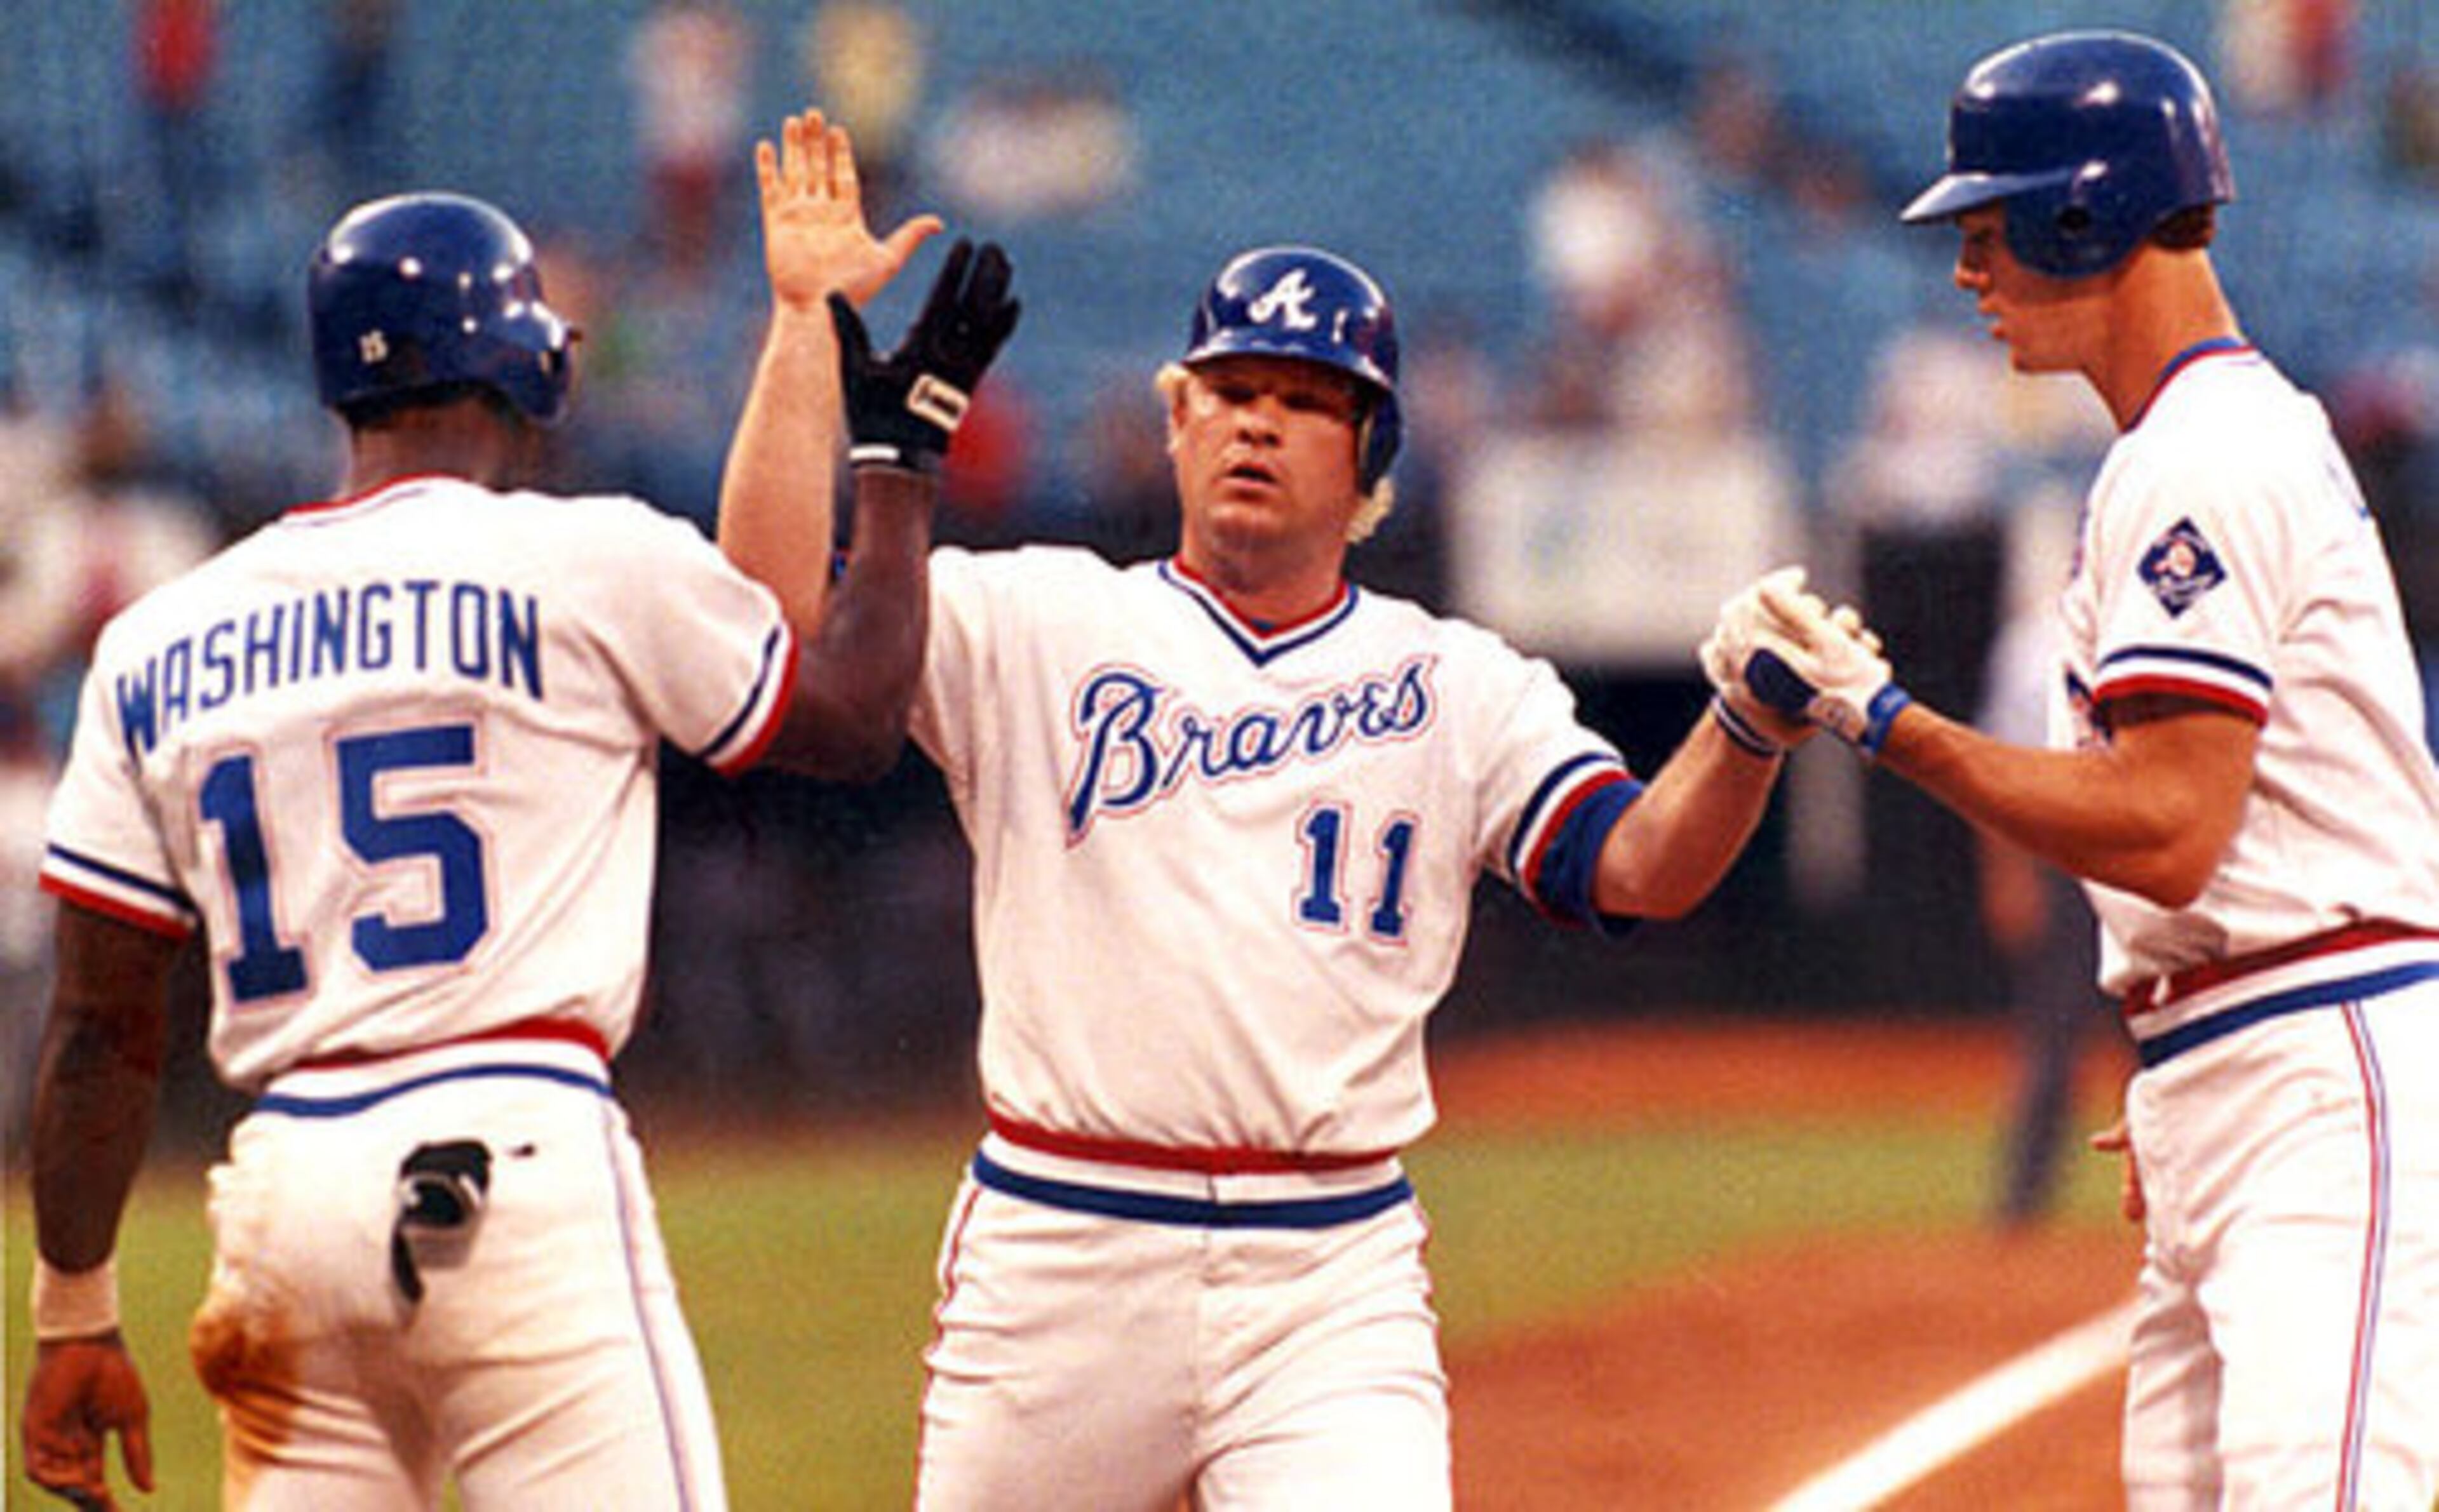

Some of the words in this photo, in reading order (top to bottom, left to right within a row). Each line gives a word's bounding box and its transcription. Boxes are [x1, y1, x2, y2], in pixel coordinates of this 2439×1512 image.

[116, 579, 545, 755] WASHINGTON
[1067, 658, 1434, 838] Braves
[196, 720, 492, 1006] 15
[1296, 804, 1417, 941] 11
